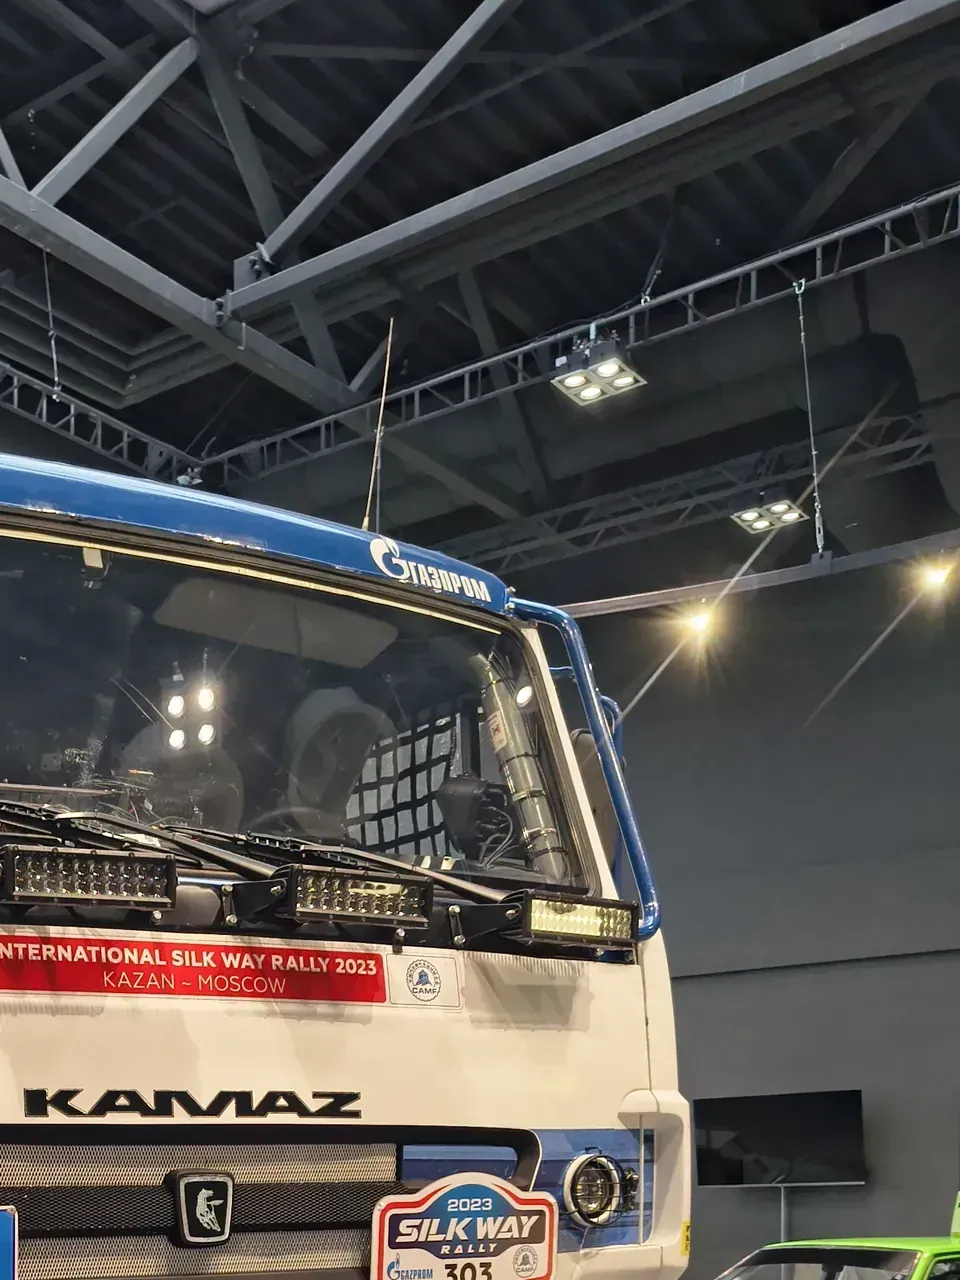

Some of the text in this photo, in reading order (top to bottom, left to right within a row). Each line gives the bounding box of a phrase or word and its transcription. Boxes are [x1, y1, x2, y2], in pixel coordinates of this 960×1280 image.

[172, 950, 217, 968] SILK
[220, 952, 266, 970] WAY
[271, 956, 330, 973] RALLY
[335, 957, 377, 976] 2023
[103, 970, 175, 990] KAZAN
[197, 974, 286, 994] MOSCOW
[411, 987, 438, 995] CAMF
[23, 1087, 362, 1119] KAMAZ
[447, 1198, 493, 1212] 2023
[395, 1215, 540, 1244] SILK WAY
[440, 1242, 498, 1255] RALLY
